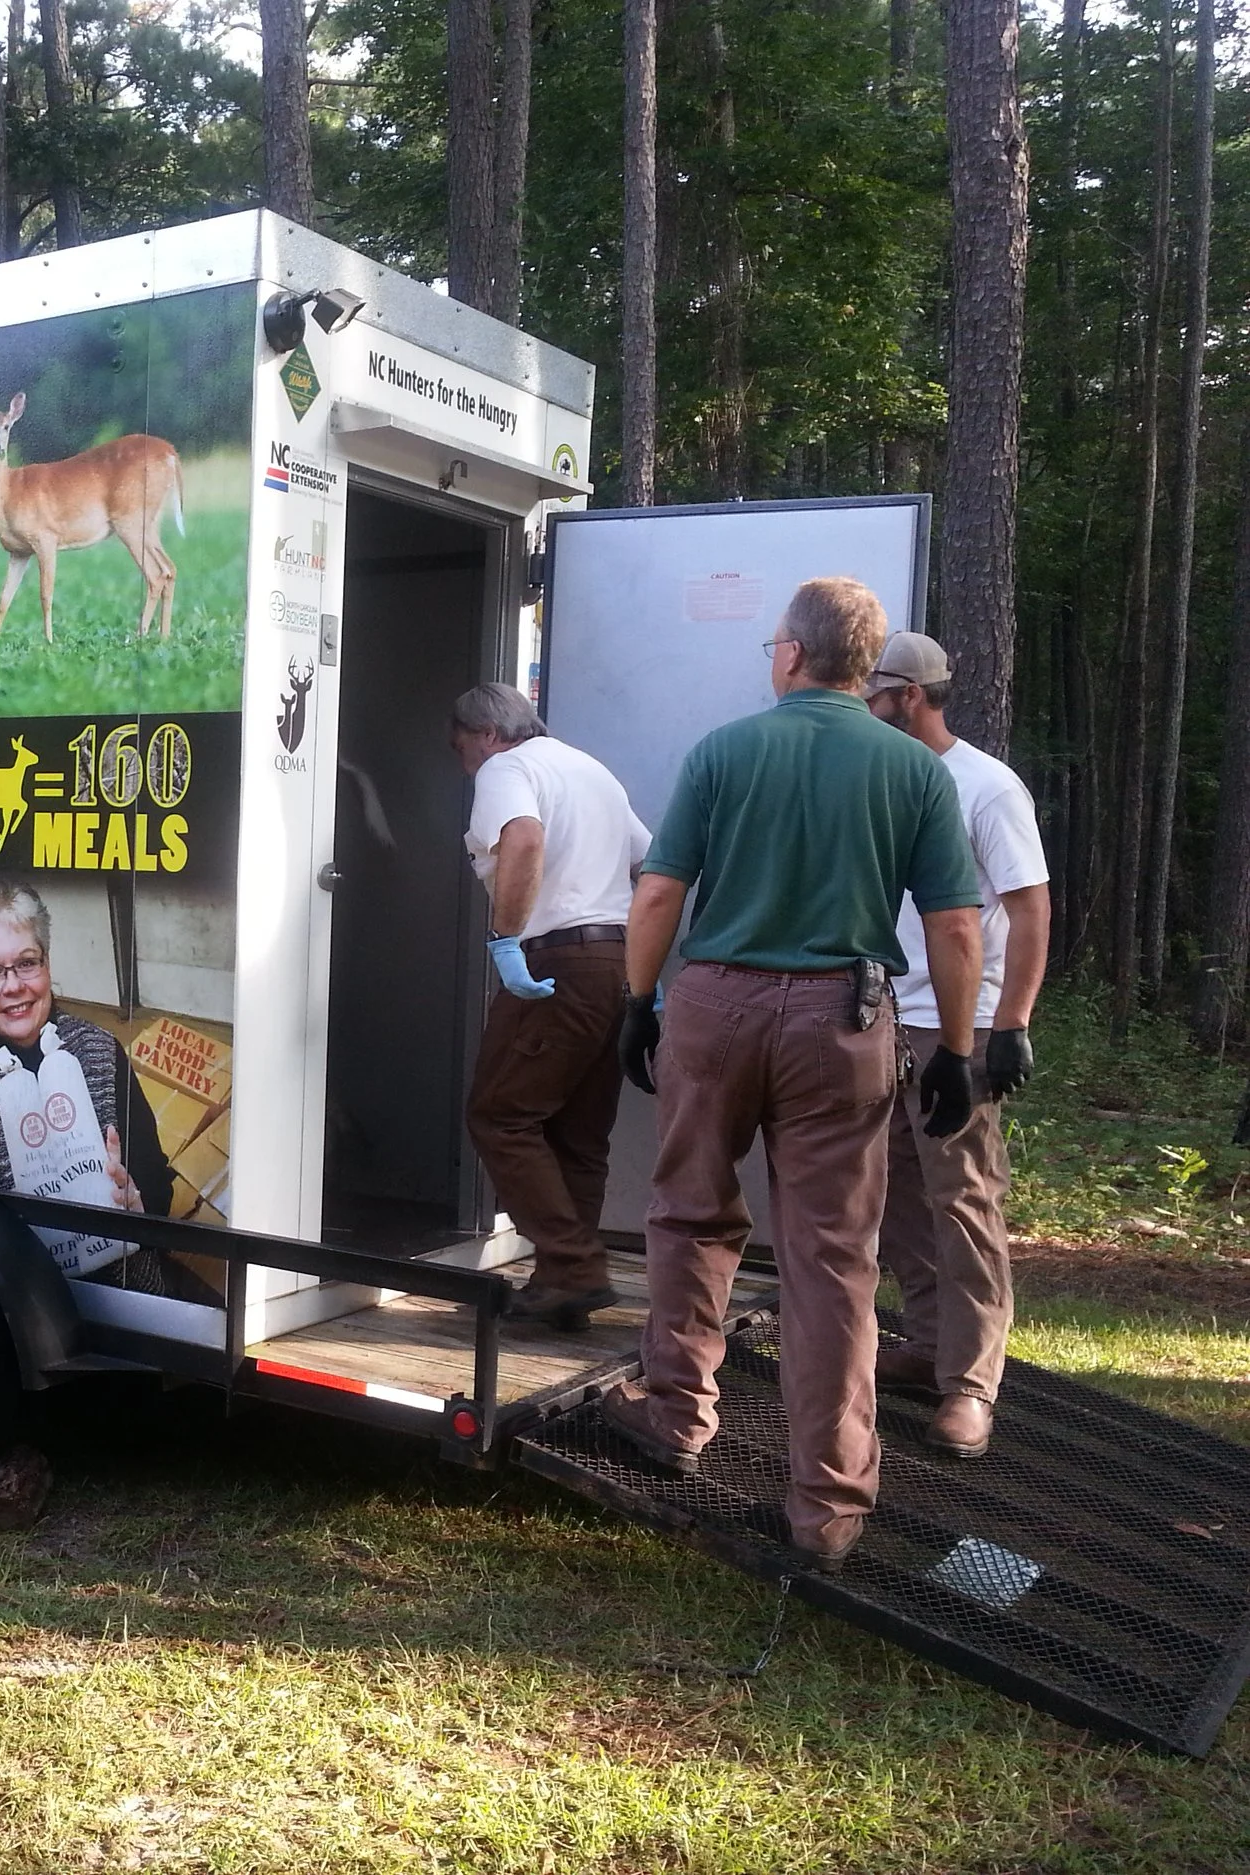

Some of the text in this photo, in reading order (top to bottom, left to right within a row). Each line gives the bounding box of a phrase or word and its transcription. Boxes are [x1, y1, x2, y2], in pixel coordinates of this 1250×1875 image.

[369, 350, 518, 436] NC Hunters for the Hungry
[271, 441, 290, 469] NC
[291, 461, 337, 484] COOPERATIVE
[291, 473, 329, 493] EXTENSION
[286, 610, 318, 628] SOYBEAN
[275, 755, 306, 774] QDMA
[33, 812, 189, 873] MEALS
[161, 1019, 216, 1059] LOCAL
[155, 1034, 206, 1071] FOOD
[135, 1041, 217, 1095] PANTRY
[61, 1159, 104, 1185] VENISON
[33, 1180, 62, 1197] VENIS
[50, 1242, 66, 1256] OT
[86, 1238, 113, 1256] SALE
